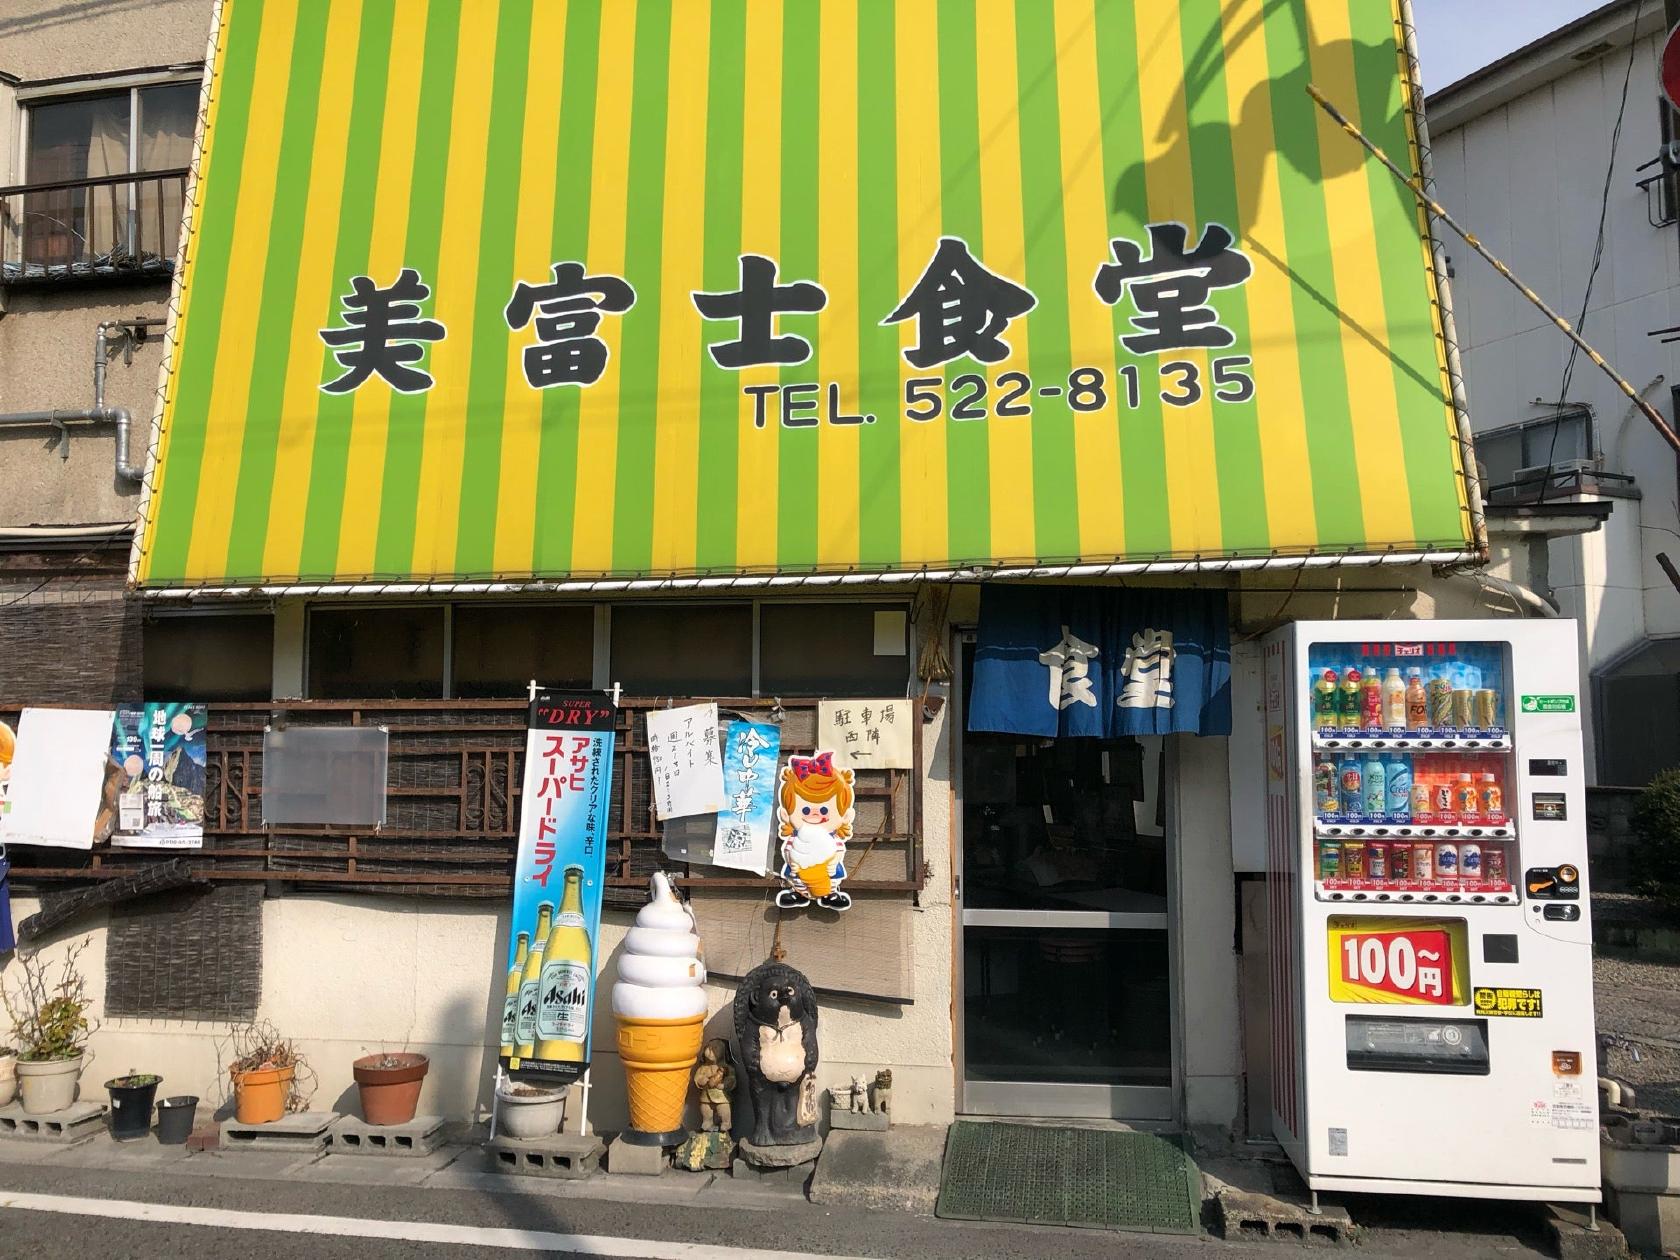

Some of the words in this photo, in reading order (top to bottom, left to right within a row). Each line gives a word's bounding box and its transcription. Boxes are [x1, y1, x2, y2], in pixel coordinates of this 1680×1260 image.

[319, 221, 1254, 395] 美富士食堂
[743, 382, 877, 429] TEL.
[905, 356, 1256, 423] 522-8135
[1038, 624, 1176, 710] 食堂
[562, 700, 592, 708] SUPER
[833, 704, 895, 727] 駐車場
[148, 709, 167, 817] 地球一周の船旅
[569, 736, 591, 791] アサヒ
[683, 717, 695, 768] アルバイト
[703, 726, 719, 767] 募集
[532, 736, 567, 887] スーパードライ
[543, 985, 586, 1007] Asahi
[557, 1011, 569, 1021] 生
